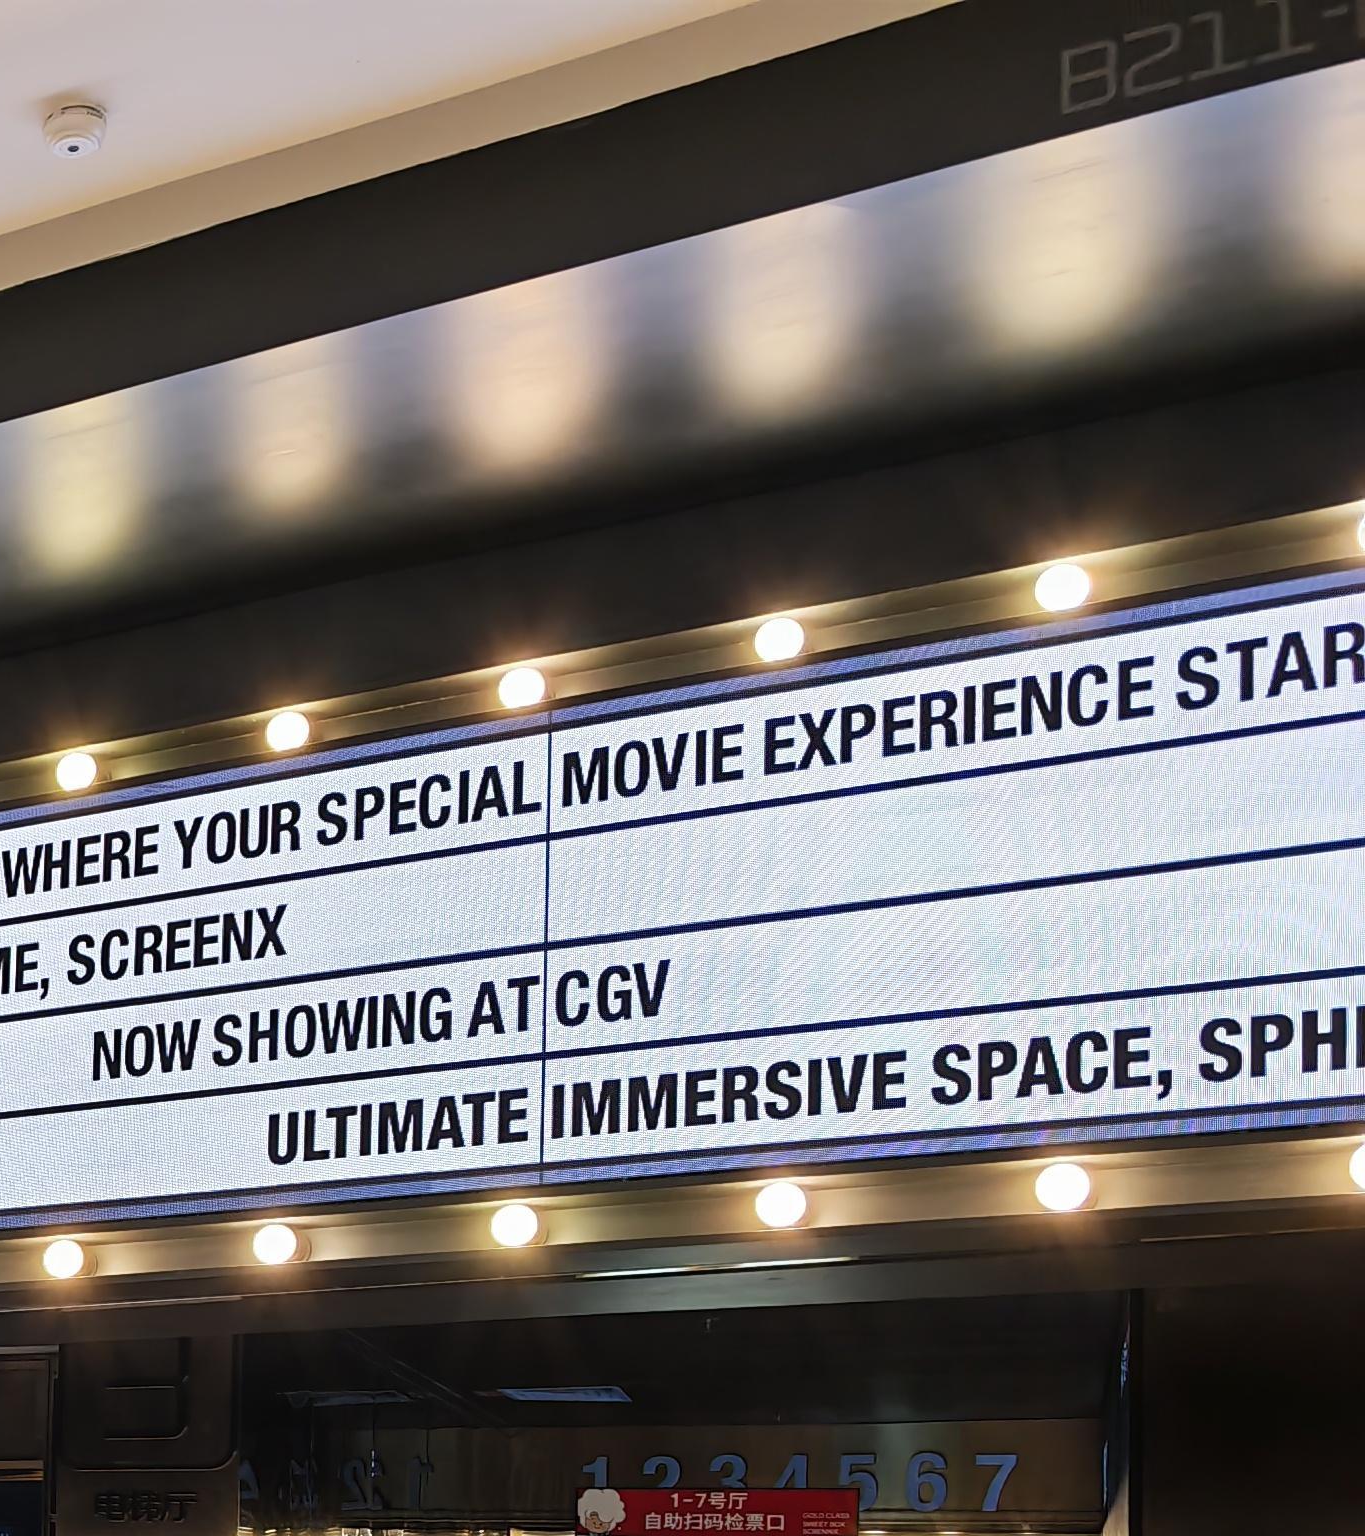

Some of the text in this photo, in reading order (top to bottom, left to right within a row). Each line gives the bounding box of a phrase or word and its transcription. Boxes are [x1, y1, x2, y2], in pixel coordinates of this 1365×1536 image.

[1061, 0, 1365, 115] B211-
[2, 824, 159, 898] WHERE
[174, 801, 301, 869] YOUR
[317, 761, 541, 846] SPECIAL
[562, 724, 745, 807] MOVIE
[764, 656, 1155, 776] EXPERIENCE
[67, 904, 287, 985] SCREENX
[93, 959, 671, 1081] NOW SHOWING AT CGV
[268, 1004, 1365, 1165] ULTIMATE IMMERSIVE SPACE, SPH
[644, 1512, 785, 1532] 自助扫码检票口
[670, 1492, 749, 1510] 1-7号厅
[838, 1453, 879, 1512] 5
[905, 1451, 948, 1513] 6
[974, 1454, 1019, 1513] 7
